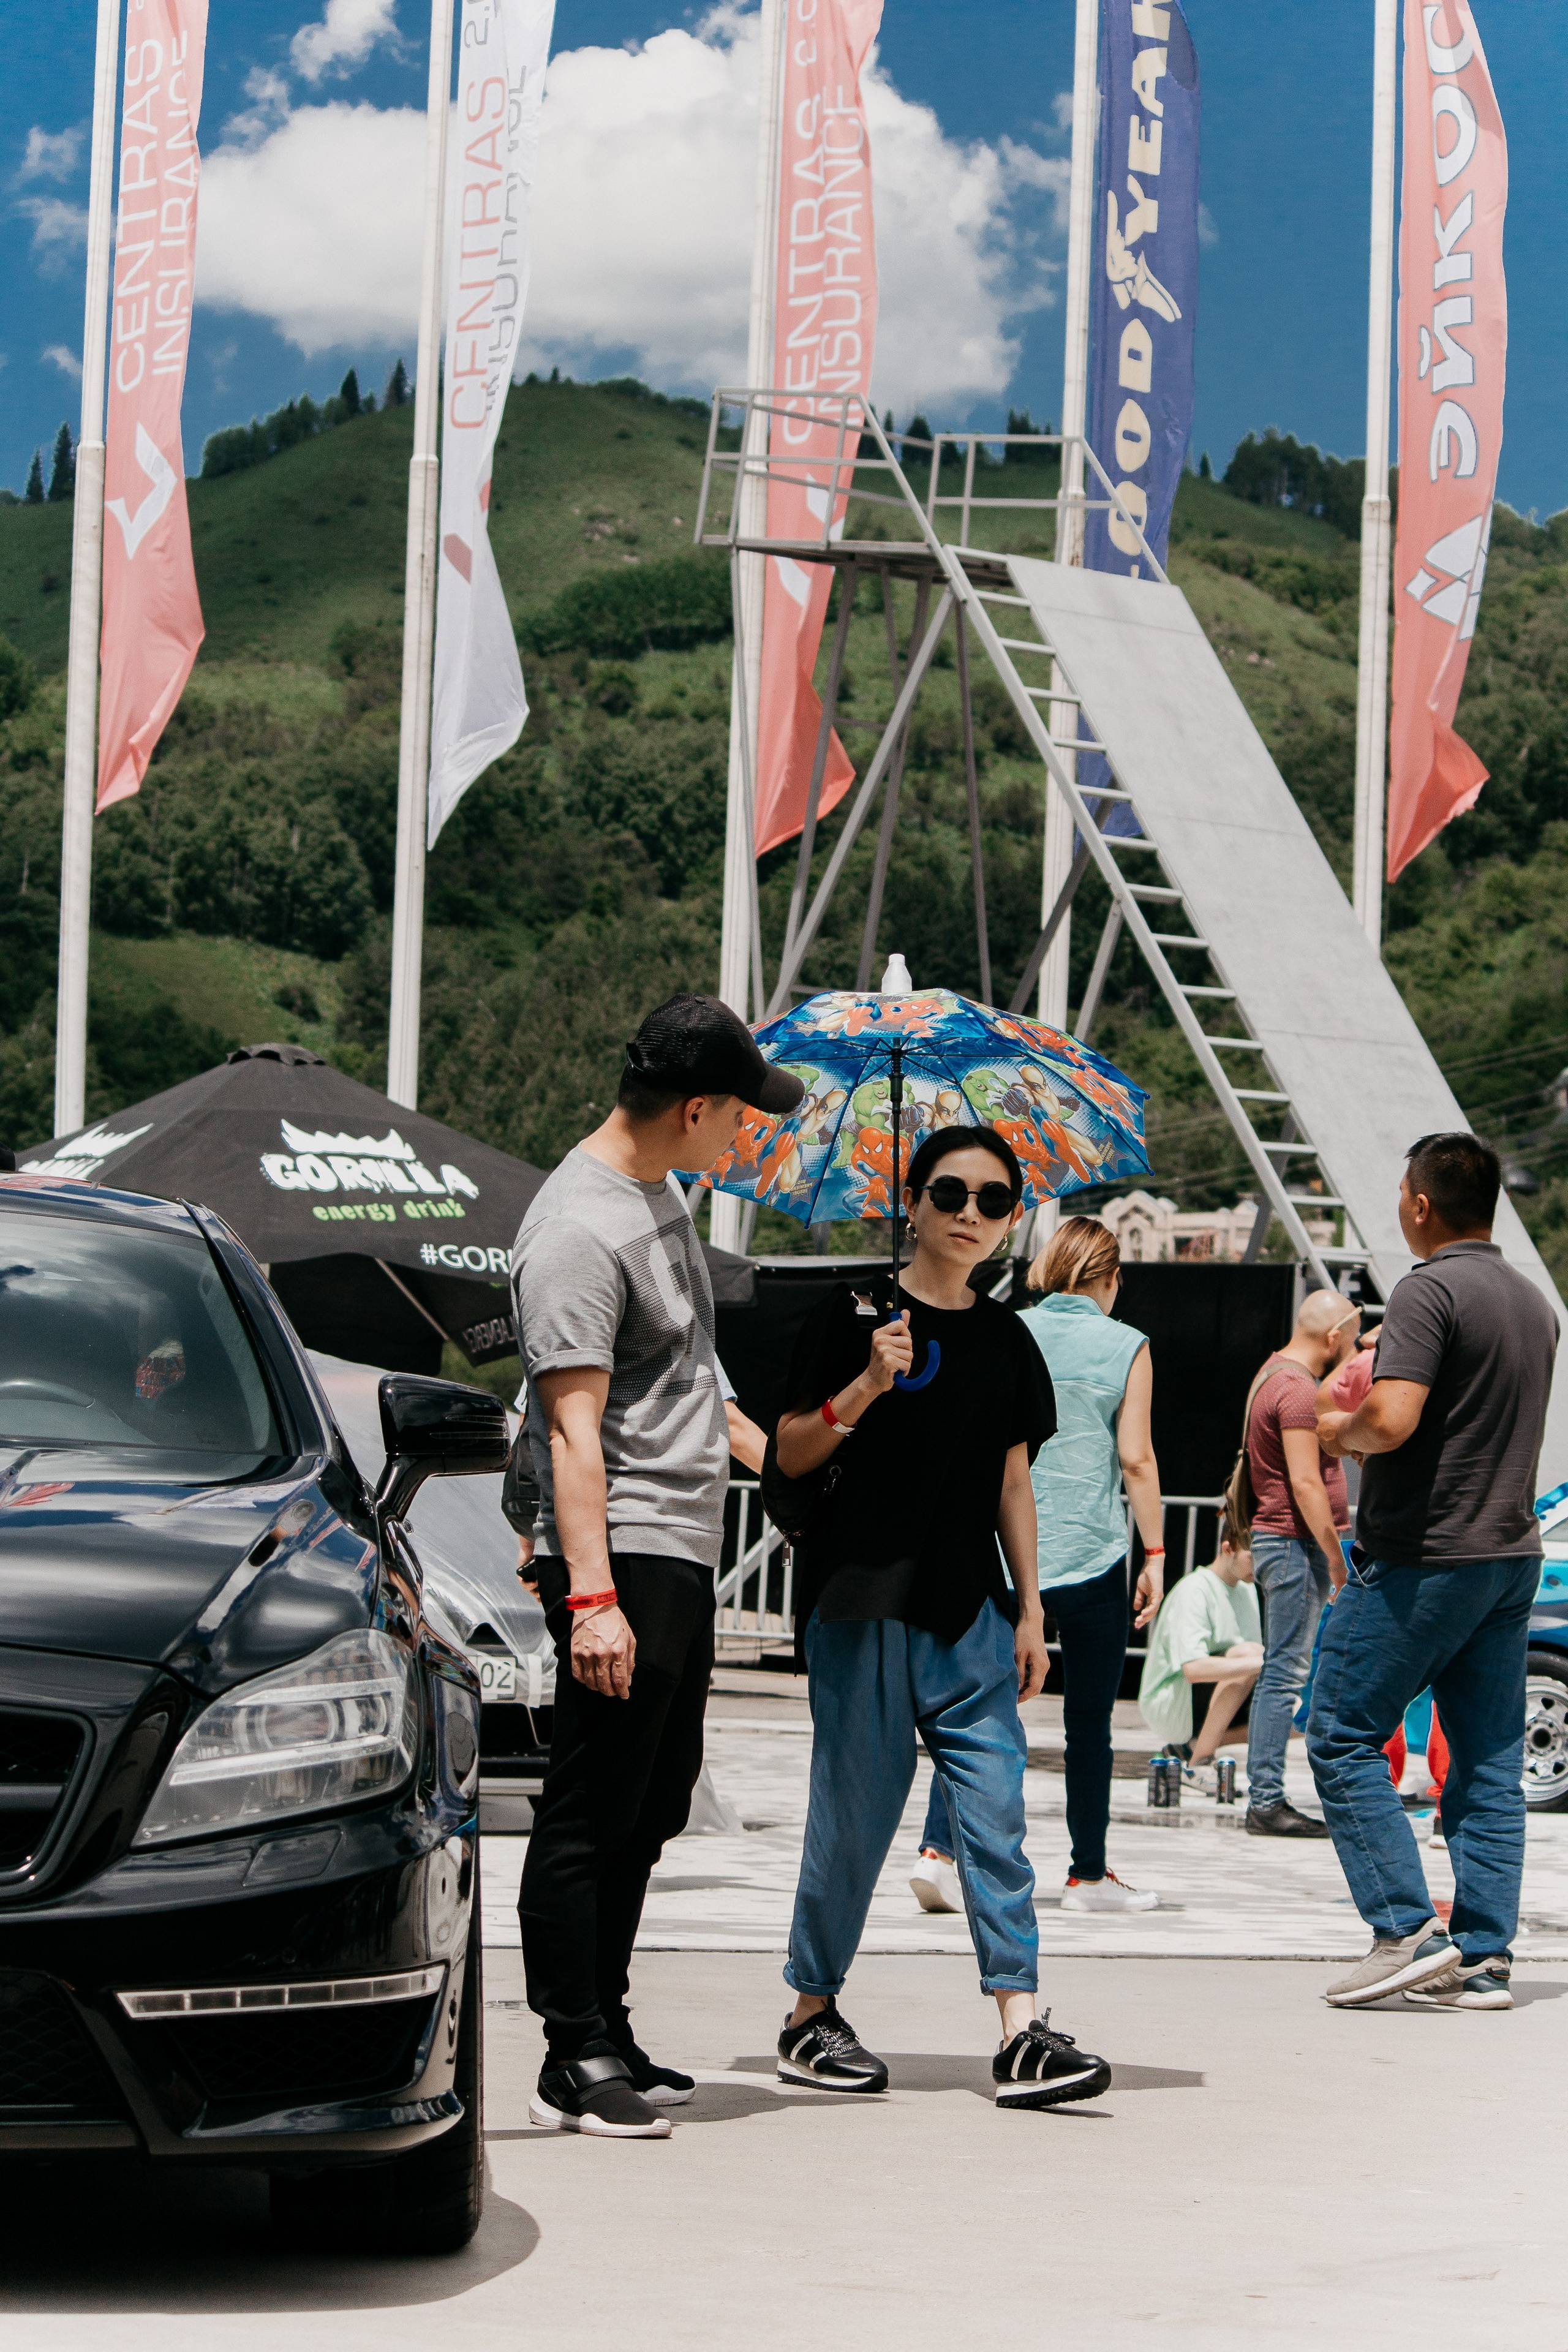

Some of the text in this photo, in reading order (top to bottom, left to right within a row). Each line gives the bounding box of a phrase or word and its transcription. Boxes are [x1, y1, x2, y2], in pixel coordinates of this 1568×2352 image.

[115, 39, 164, 393] CENTRAS
[259, 1153, 480, 1199] GORILLA
[312, 1198, 466, 1222] energy drink
[481, 1661, 512, 1689] 02
